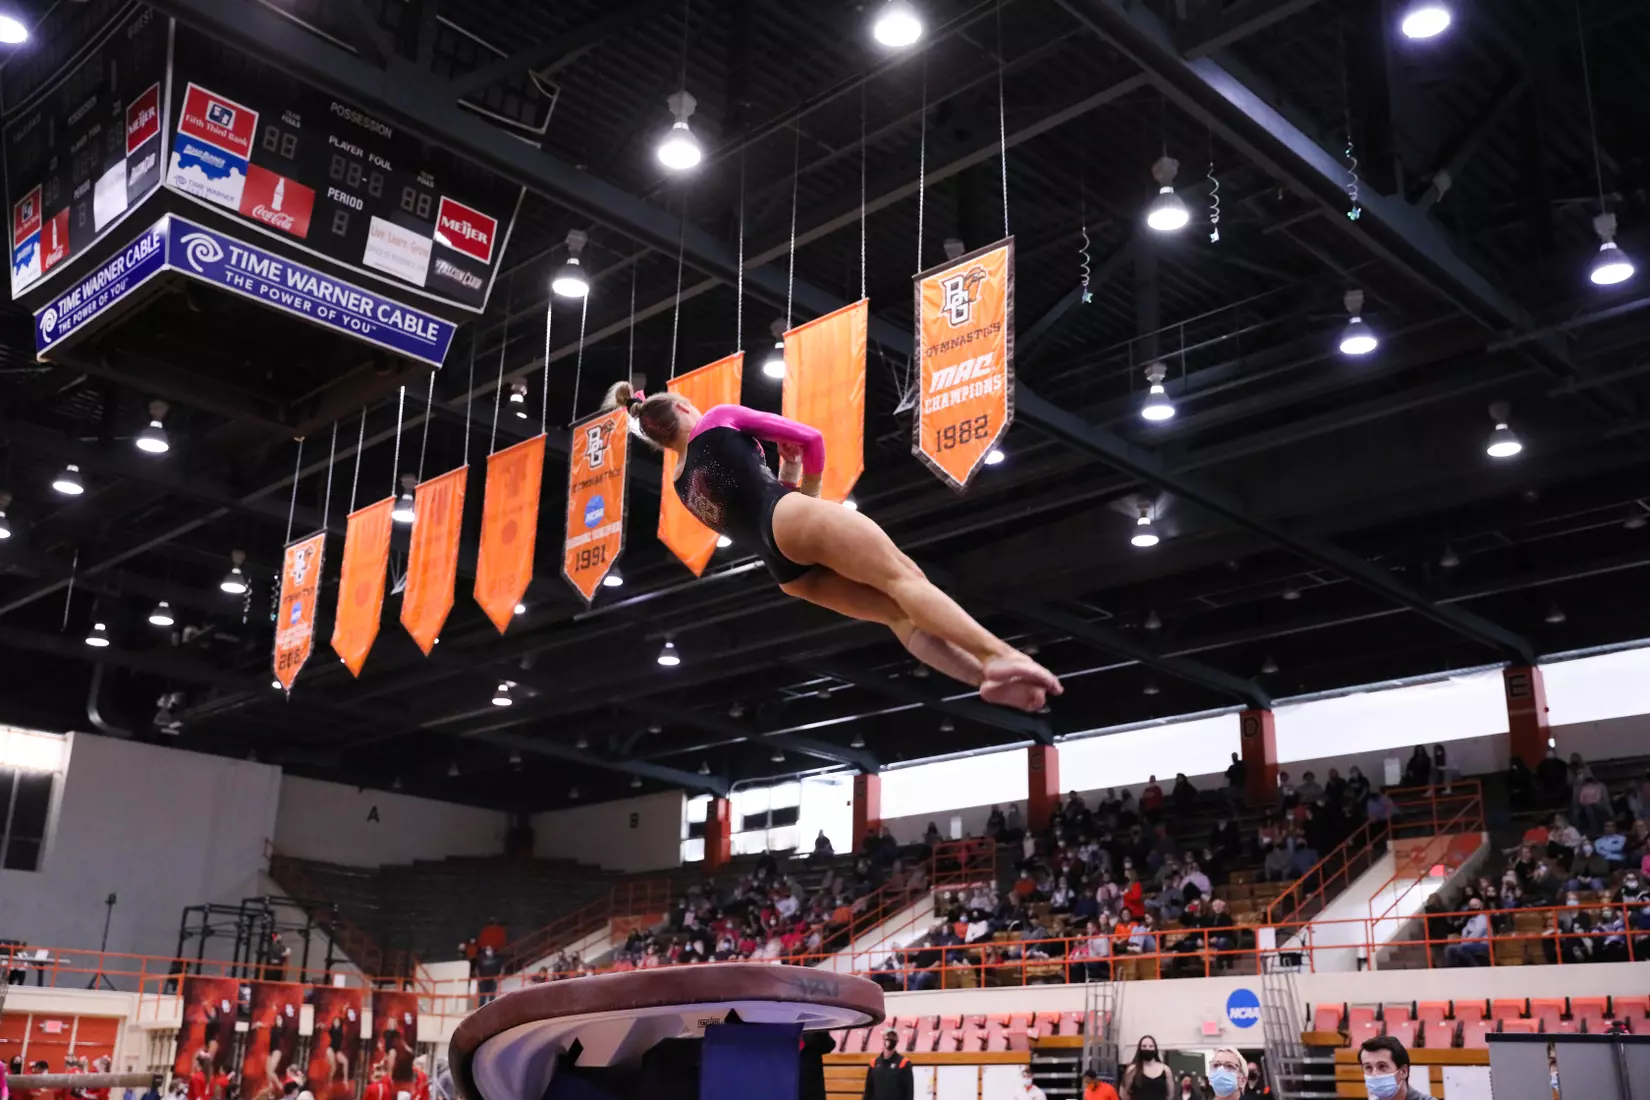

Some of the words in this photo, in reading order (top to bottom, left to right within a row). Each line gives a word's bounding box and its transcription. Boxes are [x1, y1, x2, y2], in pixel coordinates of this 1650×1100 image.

[185, 113, 204, 129] Fifth
[206, 122, 228, 138] Third
[228, 131, 248, 148] Bank
[330, 101, 392, 139] POSSESSION
[328, 135, 364, 158] PLAYER
[367, 152, 393, 171] FOUL
[327, 186, 364, 212] PERIOD
[57, 284, 82, 318] TIME
[81, 255, 125, 304] WARNER
[124, 230, 161, 268] CABLE
[225, 271, 253, 290] THE
[259, 283, 312, 313] POWER
[316, 304, 337, 320] OF
[228, 245, 282, 282] TIME
[286, 267, 375, 319] WARNER
[376, 304, 440, 342] CABLE
[58, 317, 71, 334] THE
[71, 302, 97, 324] POWER
[98, 293, 108, 306] OF
[926, 321, 1001, 358] GYMNASTICS
[929, 352, 995, 394] MAC
[924, 374, 1002, 415] CHAMPIONS
[935, 414, 989, 453] 1982
[574, 543, 607, 572] 1991
[1508, 673, 1529, 697] E
[1243, 717, 1259, 737] D
[367, 805, 380, 823] A
[629, 812, 640, 828] B
[1229, 1006, 1260, 1020] NCAA
